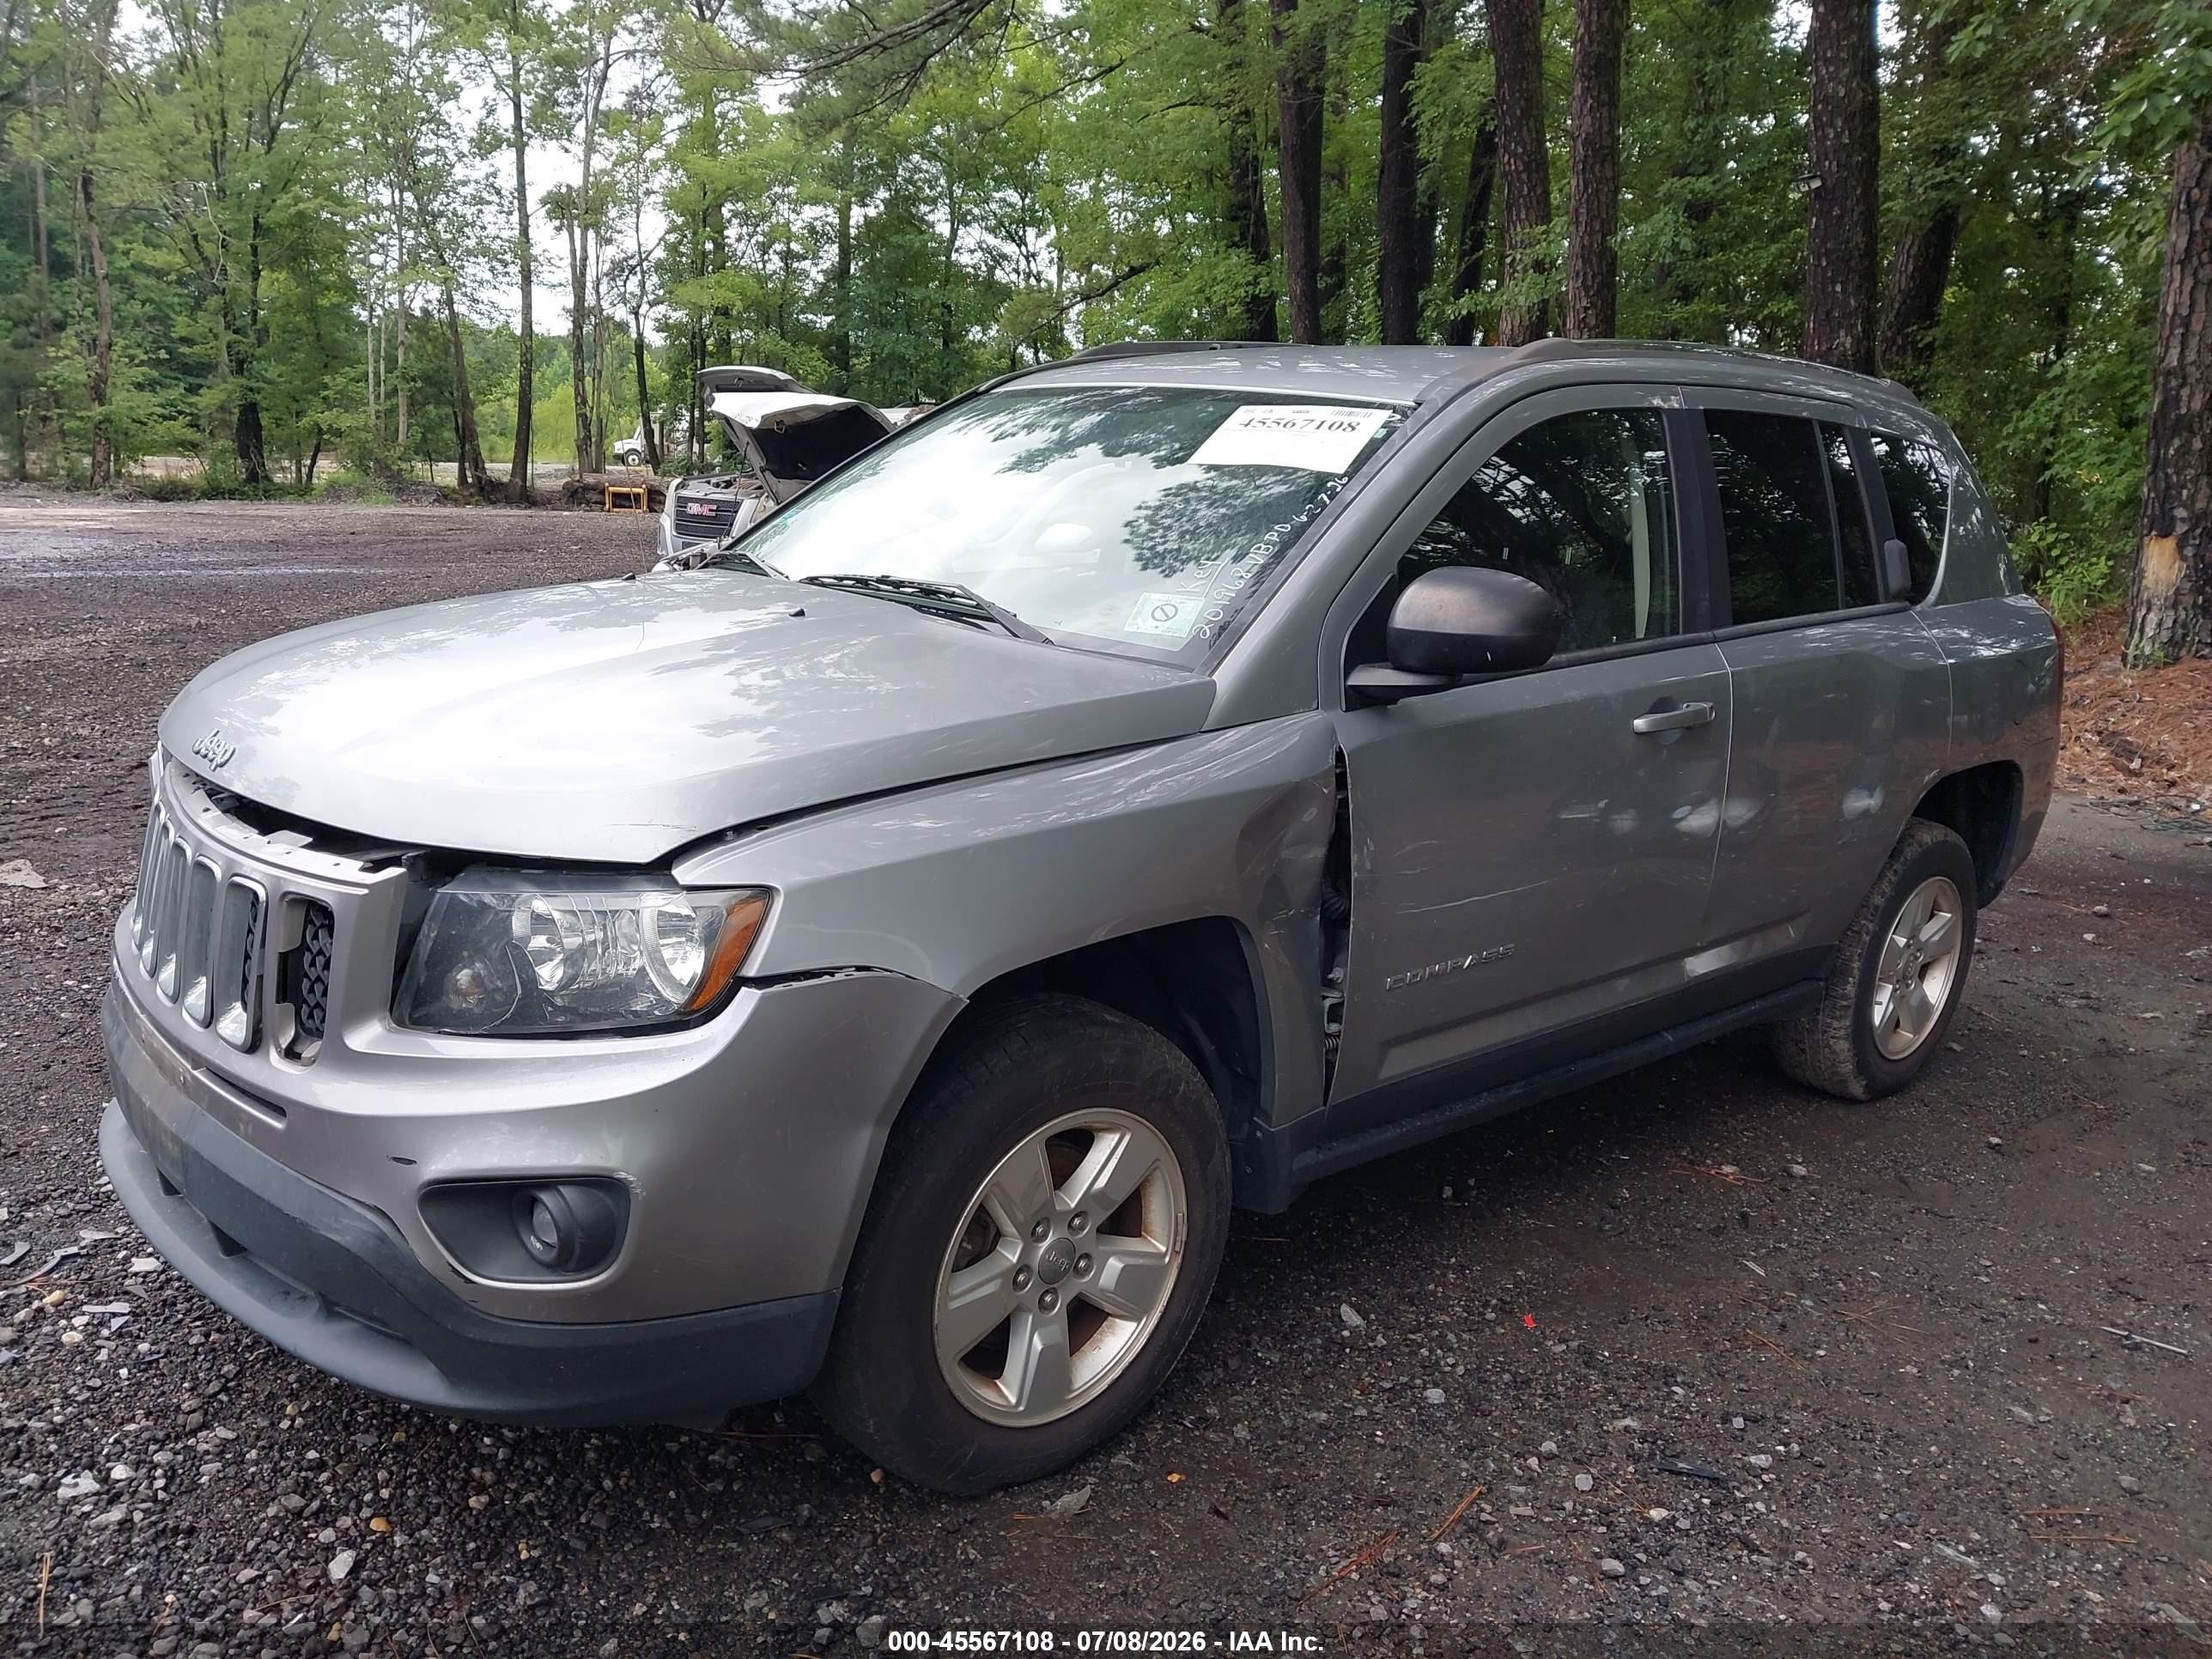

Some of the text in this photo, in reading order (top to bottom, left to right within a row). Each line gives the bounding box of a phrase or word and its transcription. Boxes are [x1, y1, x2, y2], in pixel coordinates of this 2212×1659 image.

[1238, 416, 1361, 433] 45567108
[687, 503, 716, 517] GMC
[191, 728, 236, 772] Jeep
[1386, 943, 1516, 990] COMPASS
